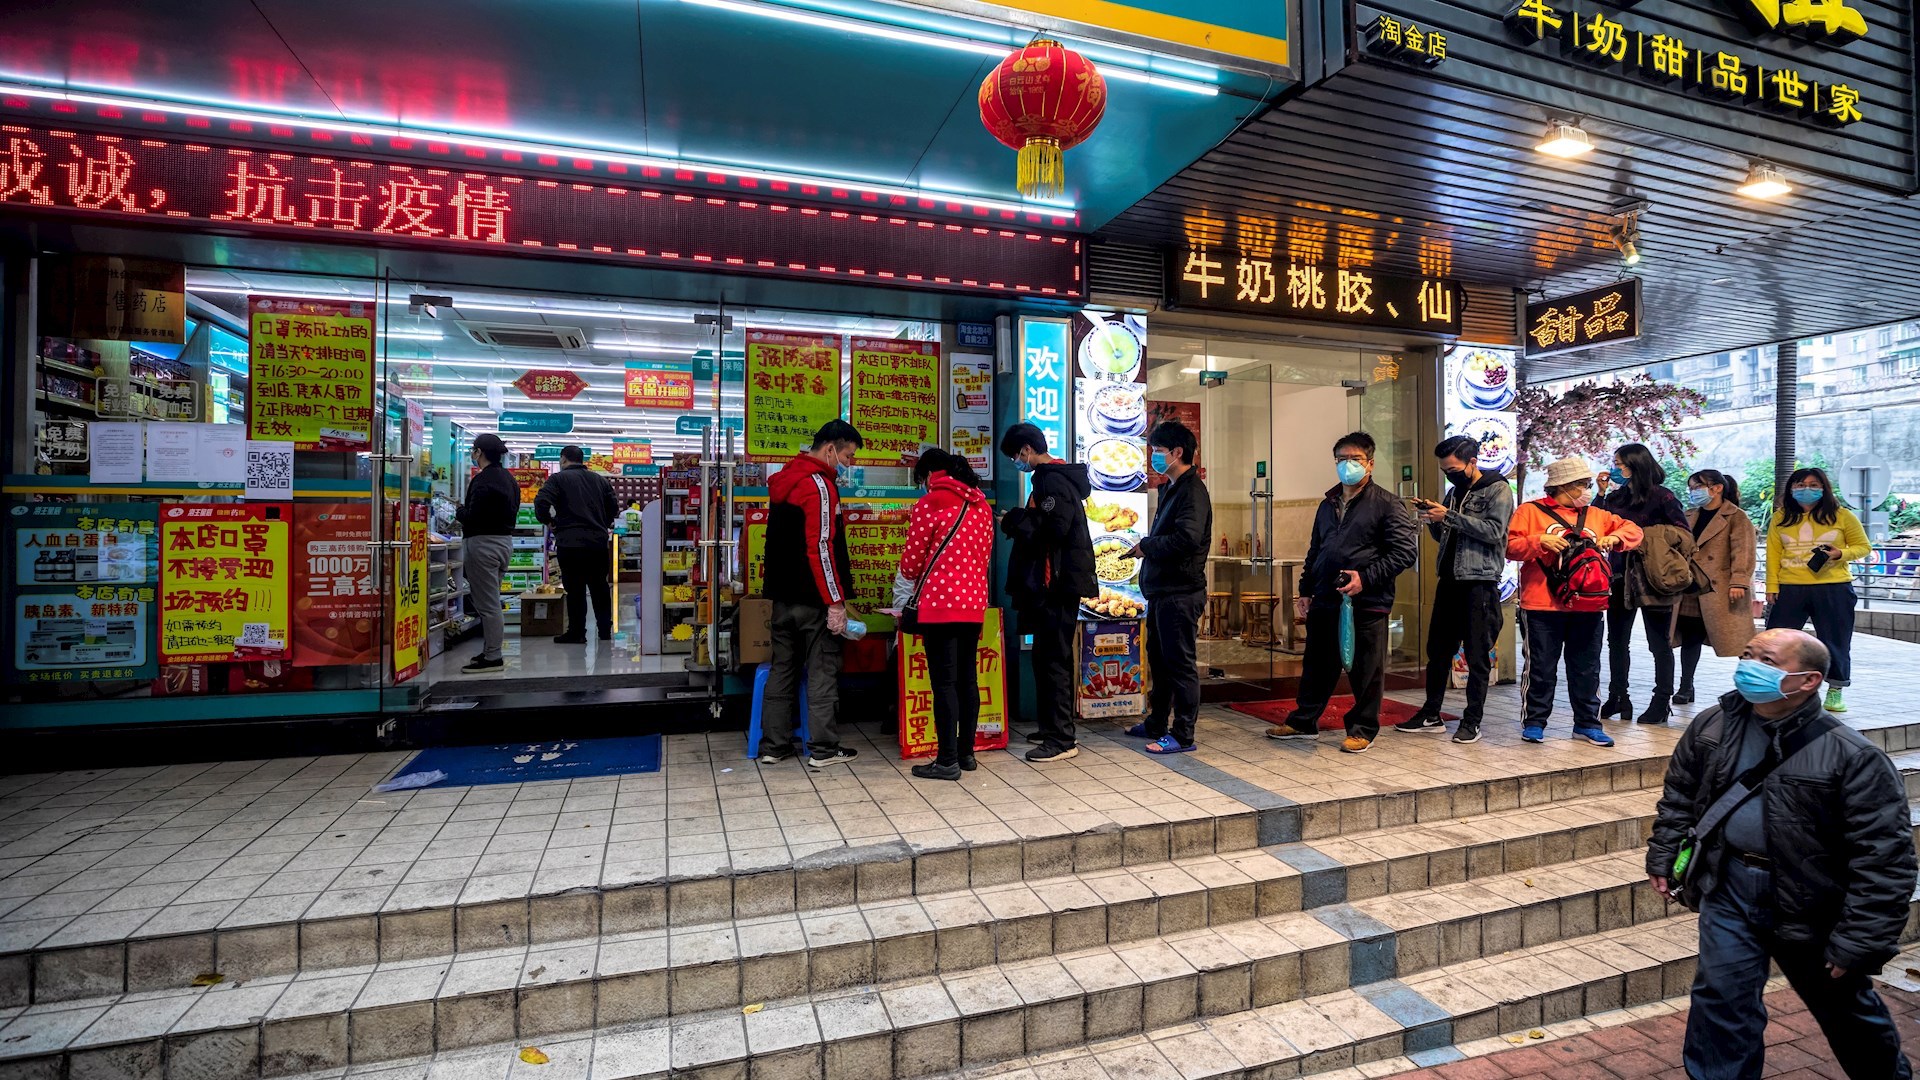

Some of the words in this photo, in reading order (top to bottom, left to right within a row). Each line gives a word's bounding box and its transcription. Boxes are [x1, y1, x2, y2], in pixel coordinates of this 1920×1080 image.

[1379, 14, 1448, 60] 淘金店
[1182, 250, 1452, 324] 牛奶桃胶、仙
[1530, 290, 1630, 348] 甜品
[857, 353, 934, 372] 本店口罩不排队
[753, 371, 828, 396] 家中常备
[1094, 371, 1129, 383] 姜撞奶
[158, 385, 192, 400] 免费
[47, 426, 83, 441] 免费
[46, 442, 82, 458] 打粉
[76, 516, 157, 535] 本店有售
[25, 533, 118, 547] 人血白蛋白
[169, 523, 270, 556] 本店口罩
[310, 544, 371, 553] 购三高药领购
[167, 557, 274, 581] 不接受现
[307, 556, 370, 575] 1000万
[76, 584, 156, 602] 本店有售
